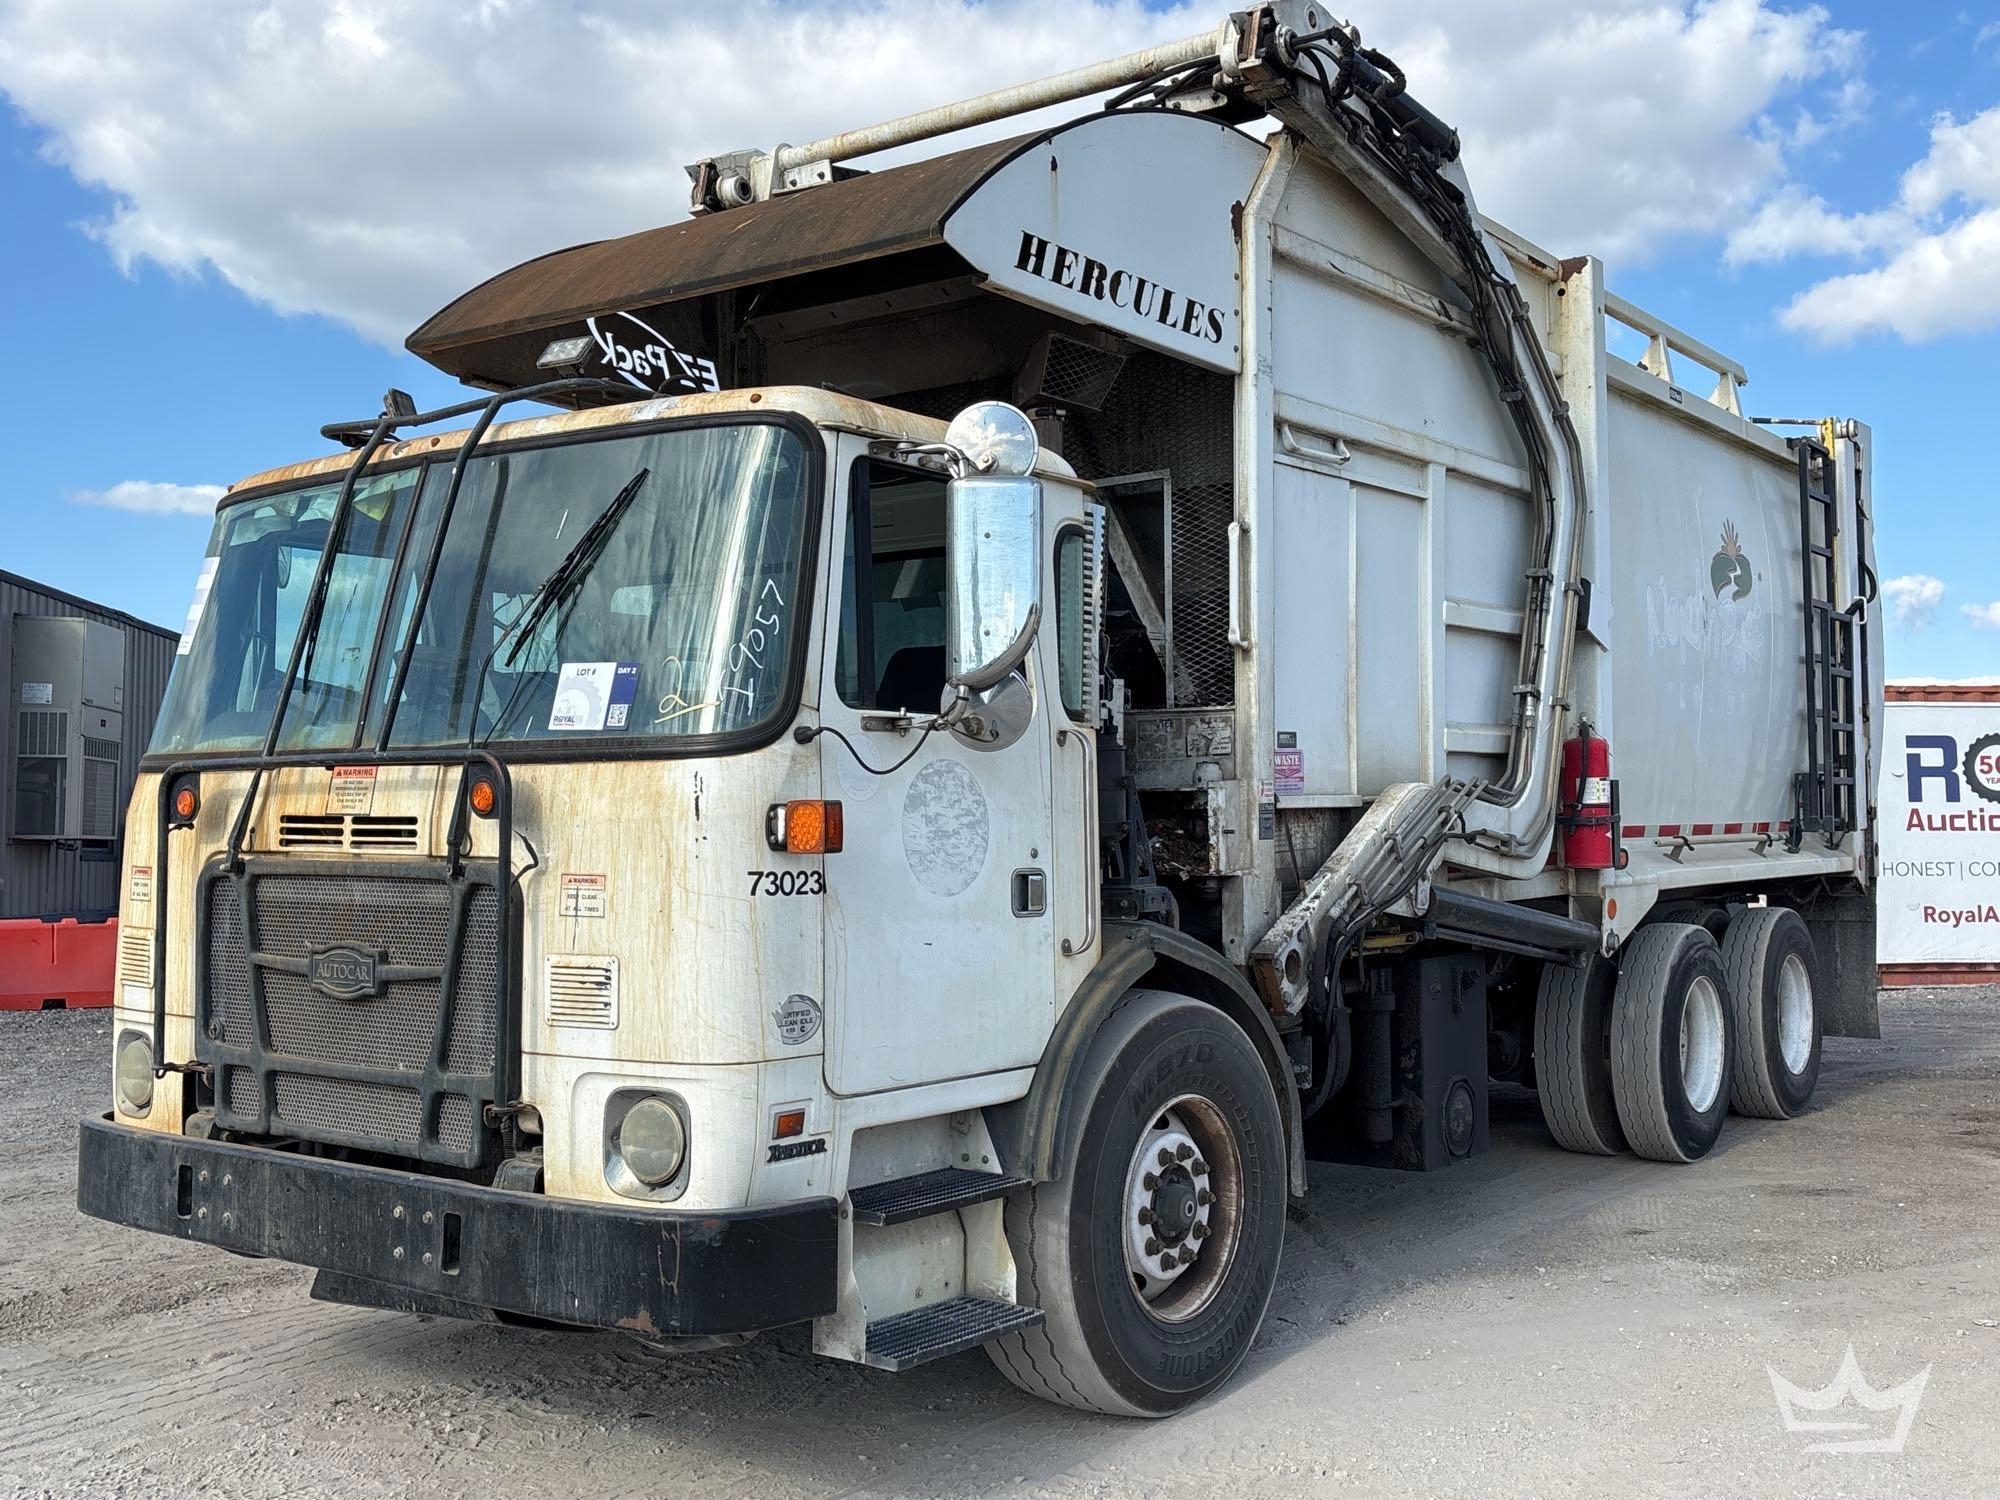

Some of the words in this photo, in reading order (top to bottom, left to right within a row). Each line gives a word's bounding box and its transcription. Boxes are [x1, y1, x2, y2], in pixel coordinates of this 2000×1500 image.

[1014, 229, 1226, 344] HERCULES
[577, 668, 592, 676] LOT
[553, 715, 576, 723] ROYAL
[1274, 754, 1300, 766] WASTE
[343, 768, 373, 776] WARNING
[1882, 861, 1955, 877] HONEST
[1968, 861, 2000, 877] CO
[747, 870, 827, 896] 73023
[317, 962, 370, 981] AUTOCAR
